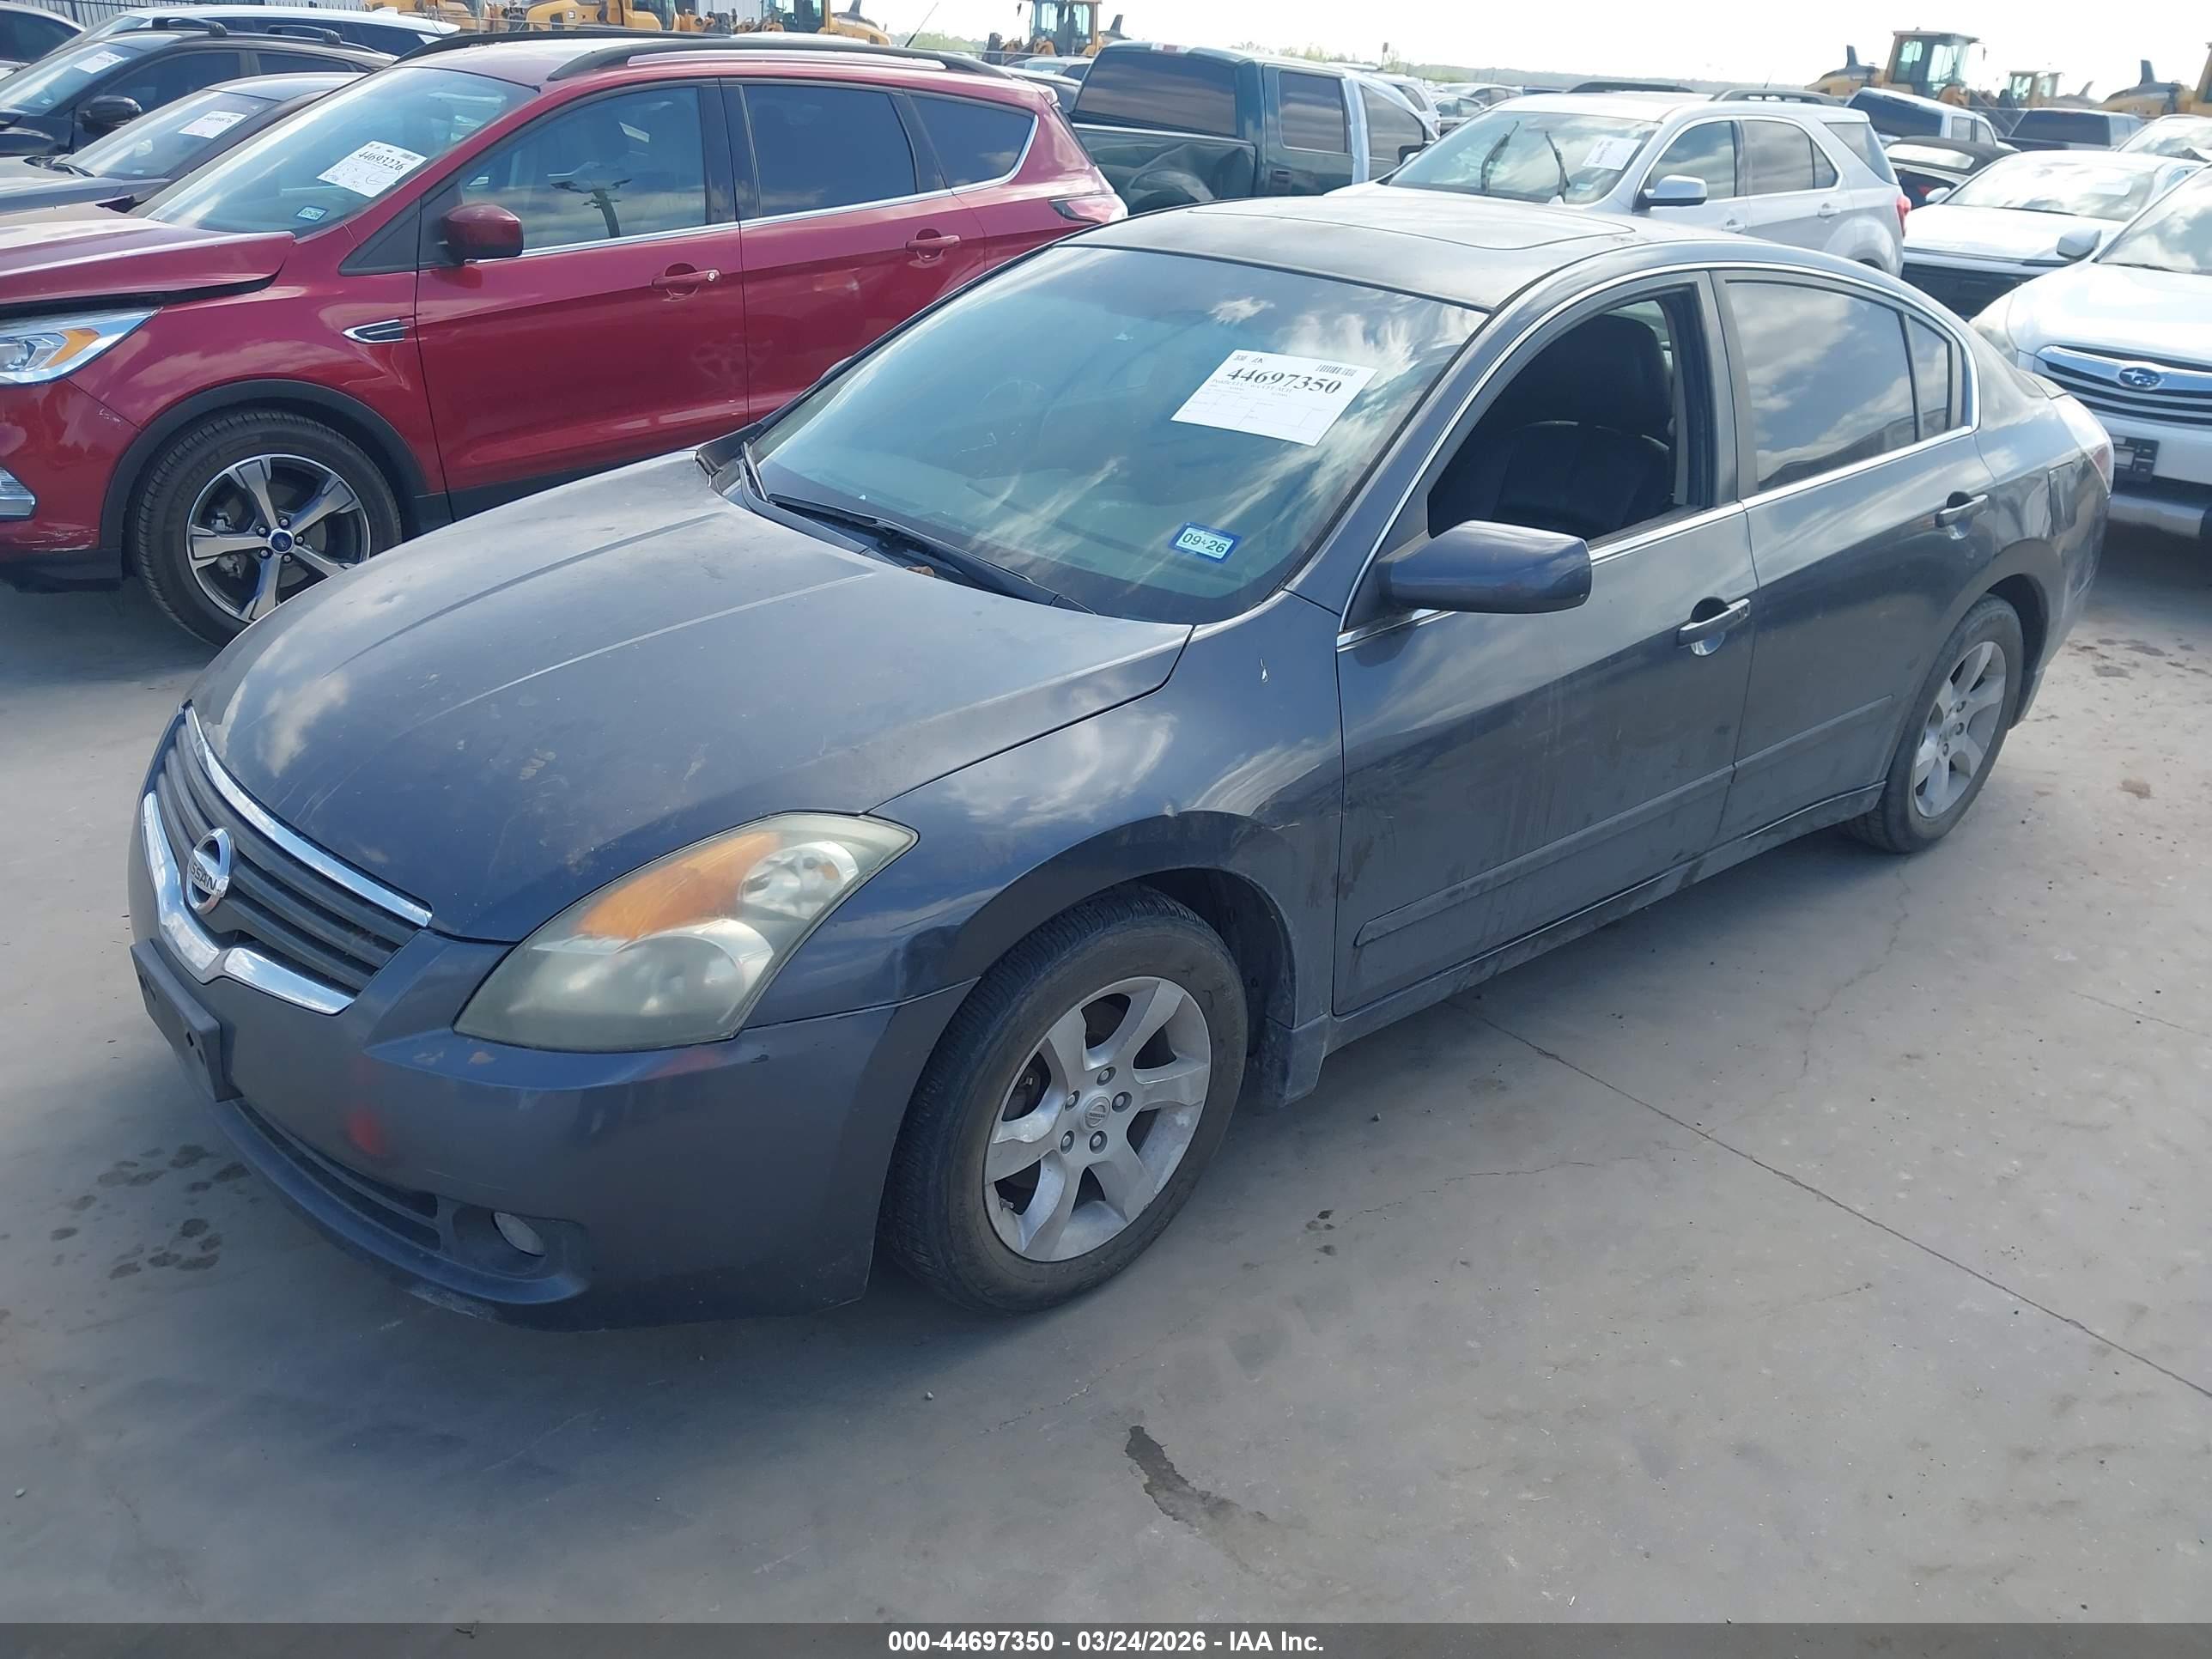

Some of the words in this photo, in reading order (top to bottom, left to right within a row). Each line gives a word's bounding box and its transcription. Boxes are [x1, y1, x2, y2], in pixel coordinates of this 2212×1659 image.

[358, 151, 404, 171] 44693226
[1226, 367, 1342, 395] 44697350
[190, 861, 218, 891] SSAN
